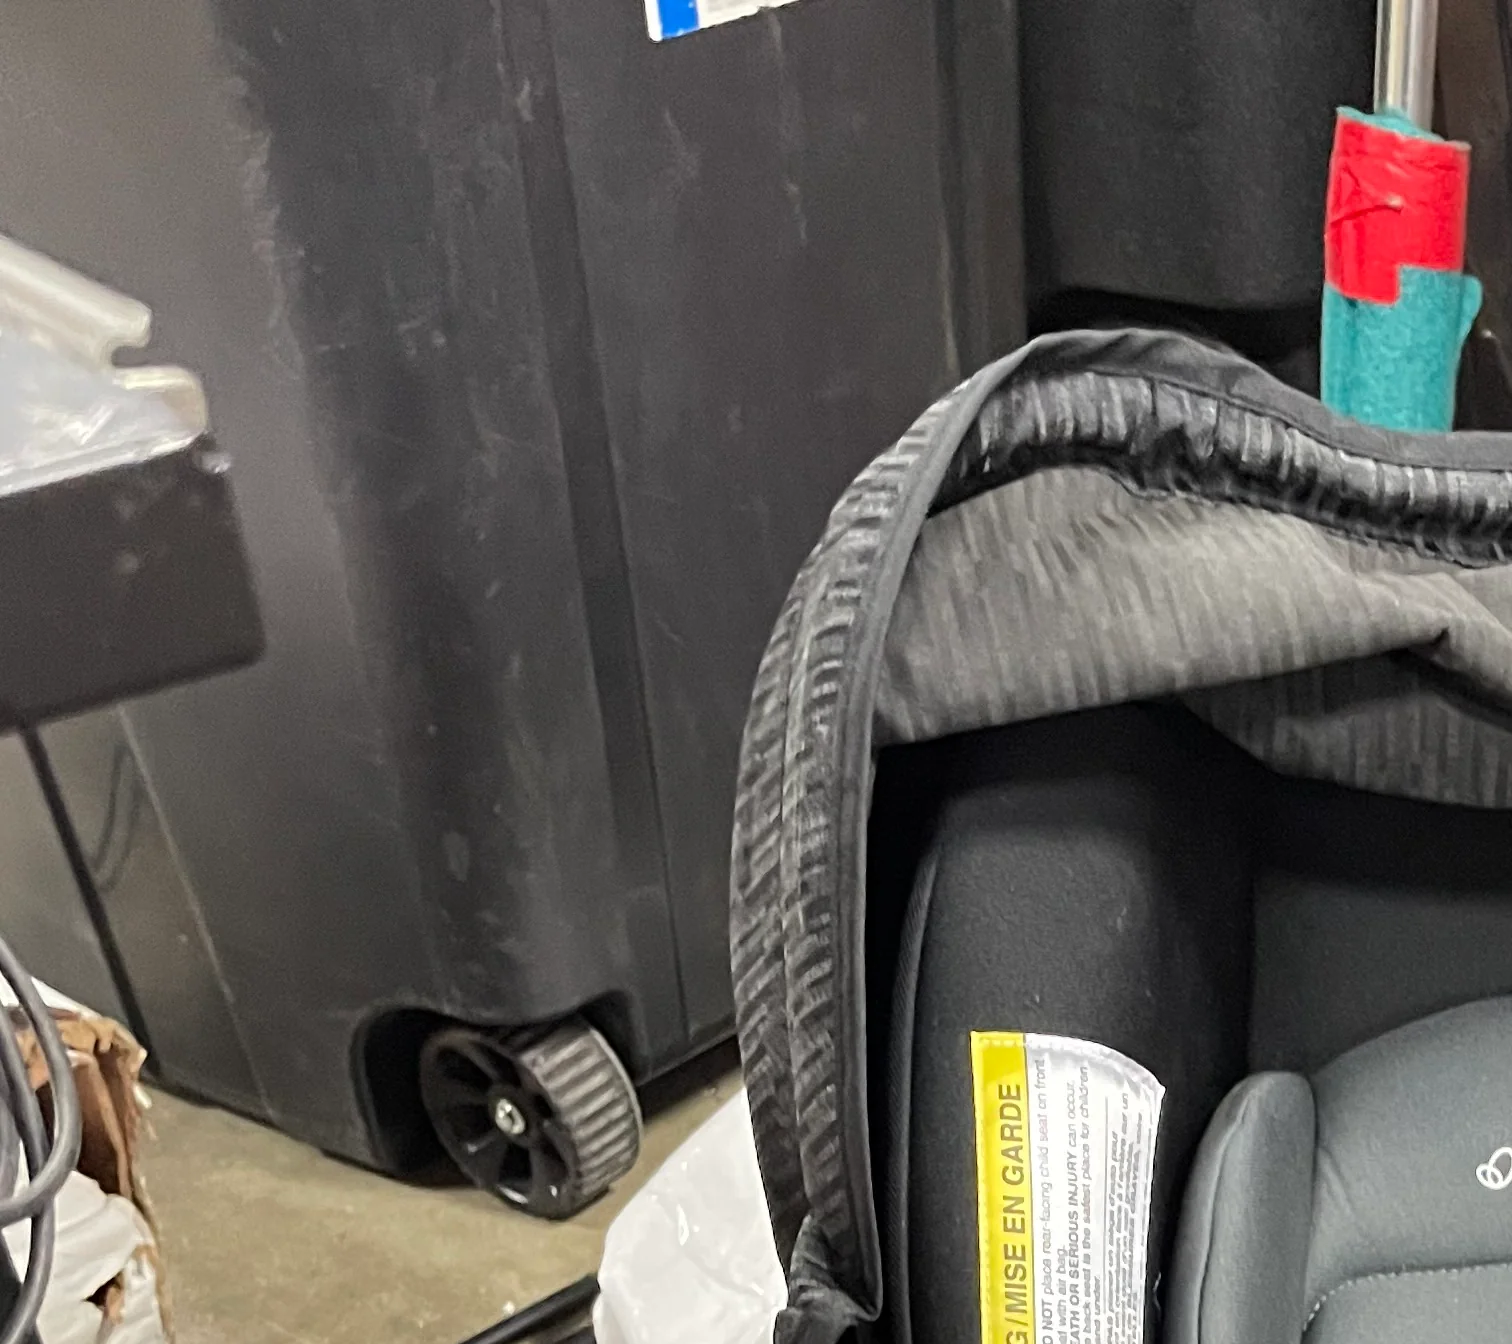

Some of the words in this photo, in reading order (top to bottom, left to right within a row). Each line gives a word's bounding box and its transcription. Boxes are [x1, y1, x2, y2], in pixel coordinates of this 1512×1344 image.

[1034, 1060, 1046, 1089] front
[1037, 1093, 1047, 1110] on
[1078, 1066, 1089, 1118] children
[998, 1084, 1025, 1186] GARDE
[1037, 1114, 1048, 1142] seat
[1067, 1124, 1076, 1148] can
[1037, 1146, 1050, 1177] child
[1066, 1151, 1078, 1206] INJURY
[1002, 1196, 1025, 1234] EN
[1068, 1210, 1080, 1279] SERIOUS
[1056, 1278, 1066, 1295] air
[1069, 1284, 1080, 1306] OR
[1041, 1298, 1053, 1330] NOT
[1056, 1299, 1066, 1326] with
